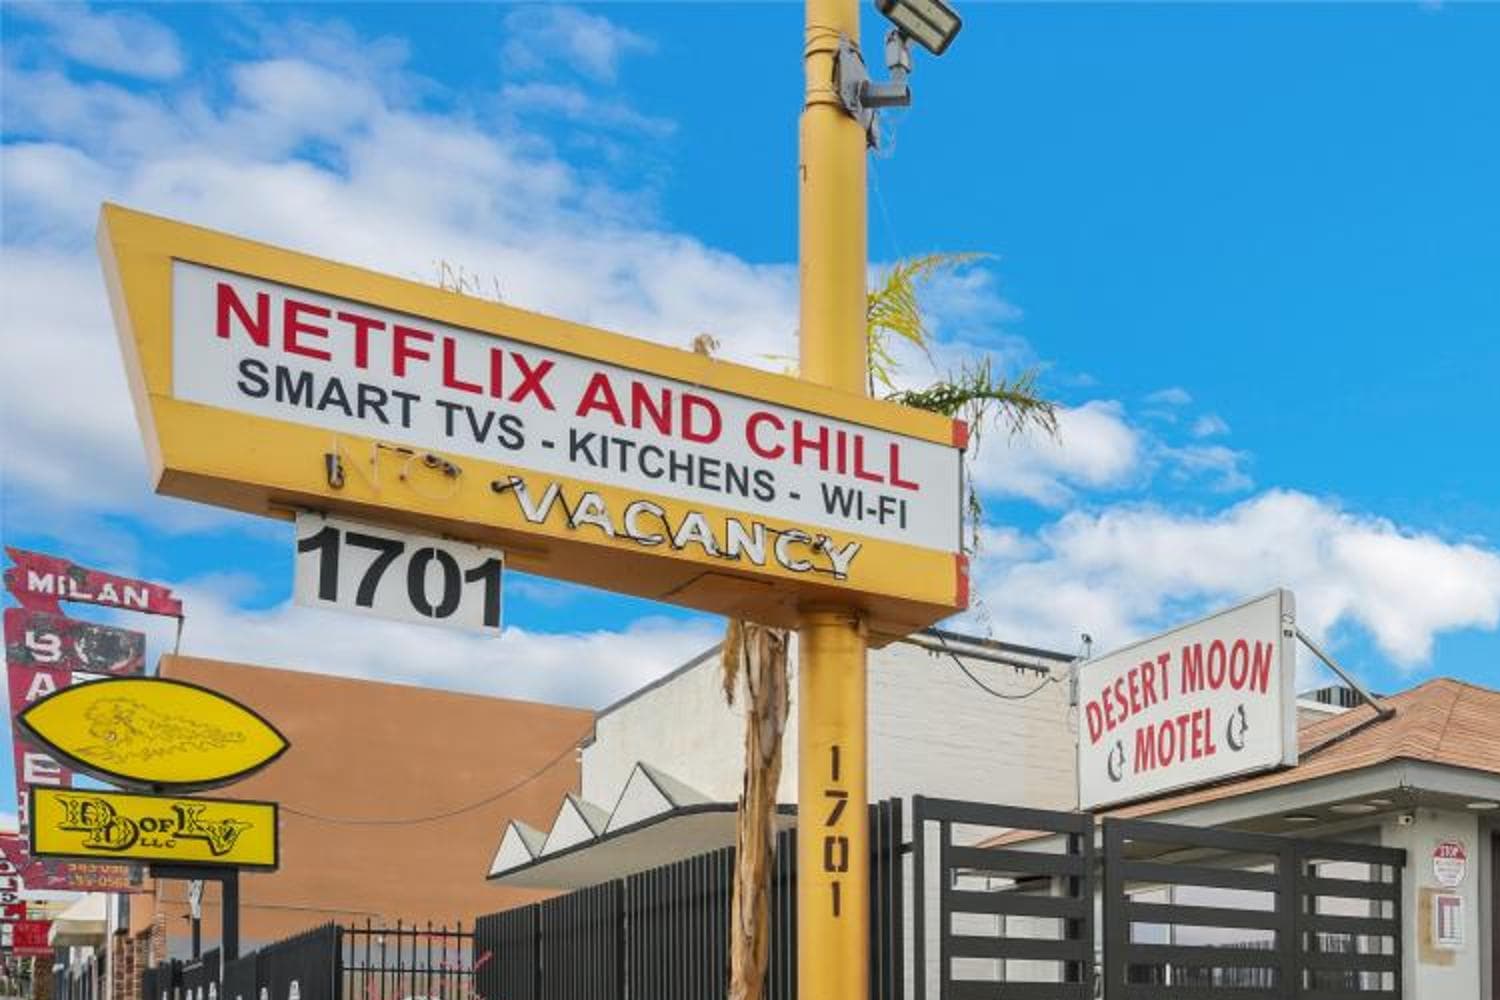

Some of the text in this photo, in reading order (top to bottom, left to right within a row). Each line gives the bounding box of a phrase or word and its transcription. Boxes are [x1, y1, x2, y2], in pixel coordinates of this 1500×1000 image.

[216, 281, 920, 491] NETFLIX AND CHILL
[237, 358, 421, 429] SMART
[435, 399, 525, 450] TVS
[568, 427, 776, 502] KITCHENS
[821, 482, 907, 530] WI-FI
[297, 525, 503, 628] 1701
[507, 475, 862, 580] VACANCY
[27, 569, 150, 609] MILAN
[1085, 638, 1274, 746] DESERT MOON
[1133, 706, 1217, 775] MOTEL
[824, 745, 848, 918] 1701
